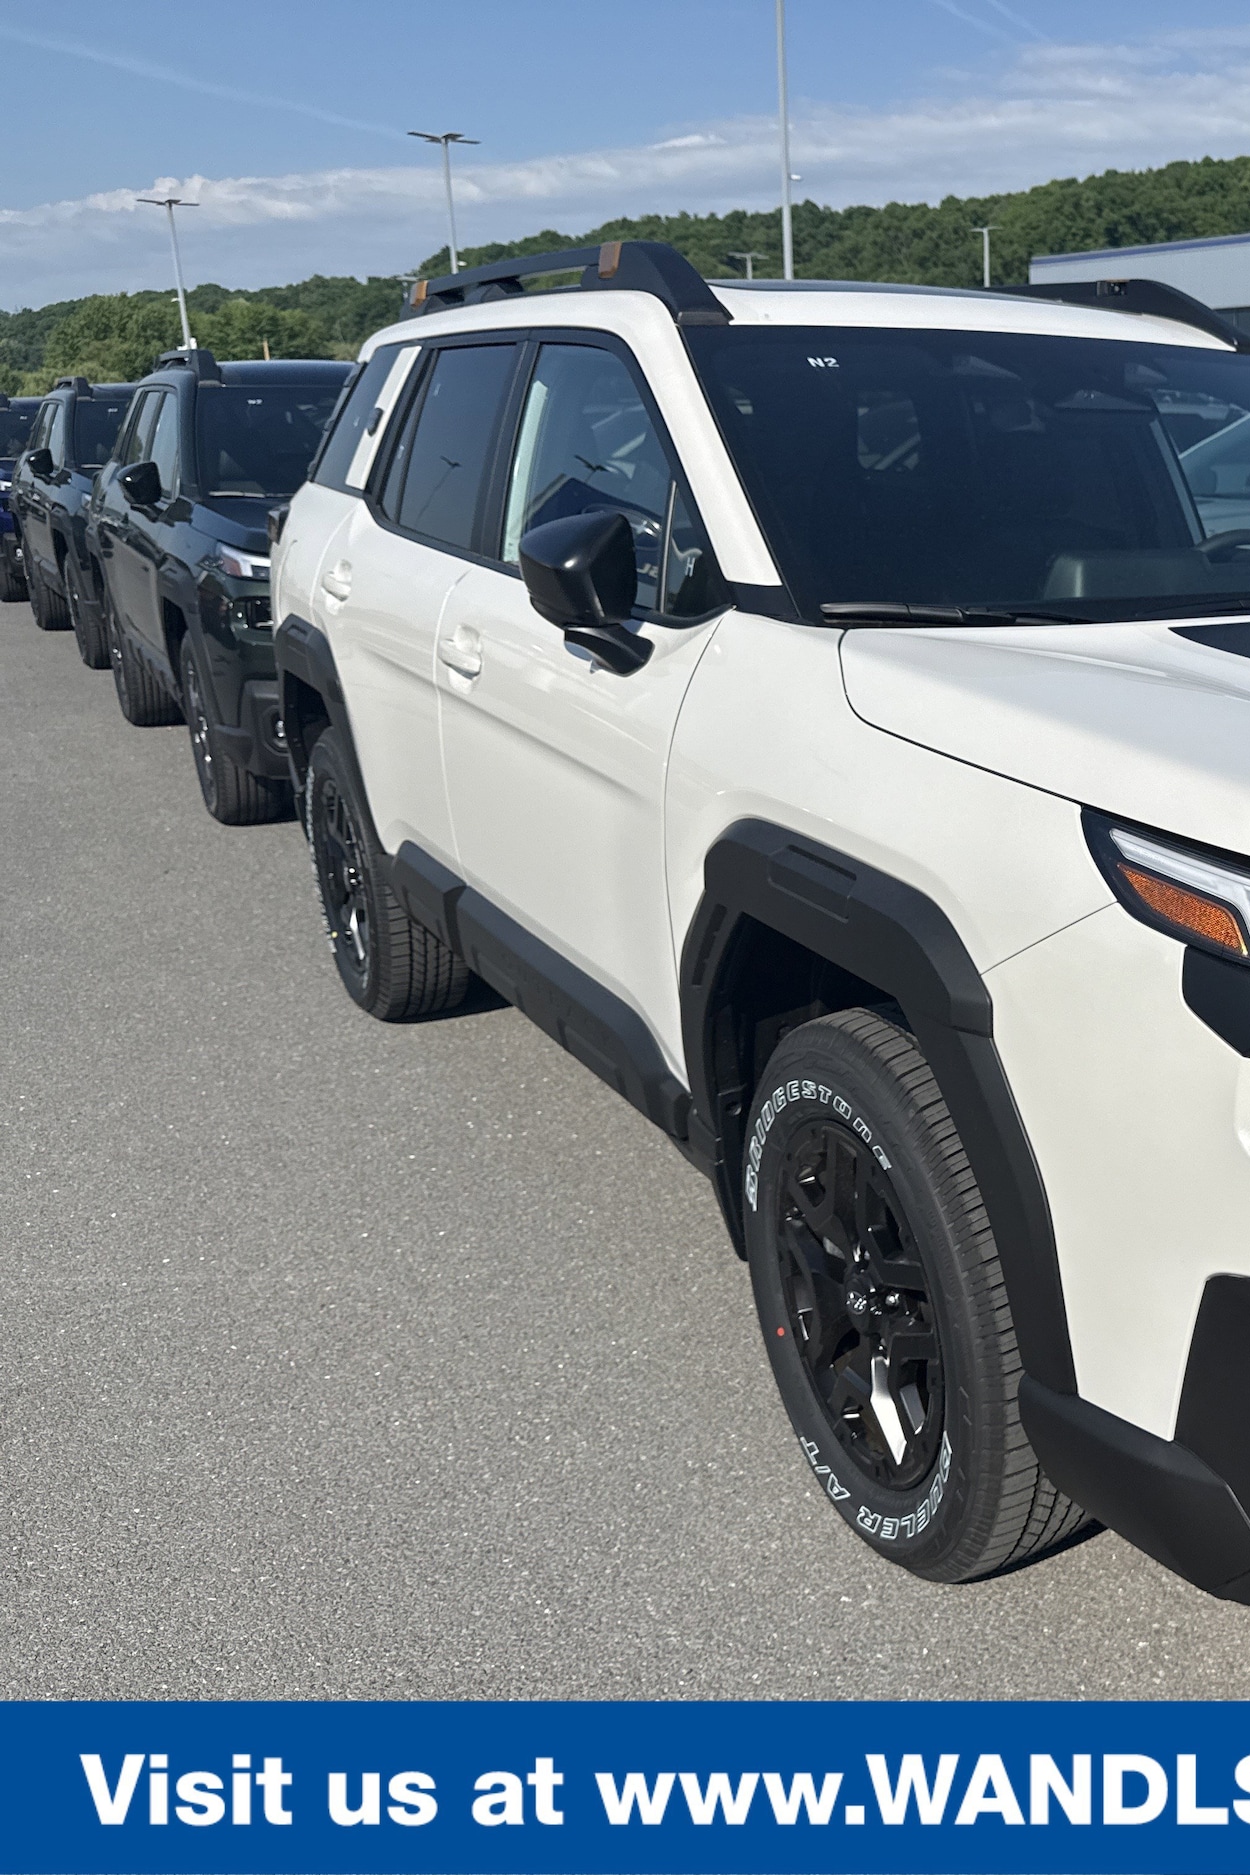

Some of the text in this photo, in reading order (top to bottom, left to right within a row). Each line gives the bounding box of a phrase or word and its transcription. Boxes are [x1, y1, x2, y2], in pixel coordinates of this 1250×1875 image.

[807, 357, 839, 368] N2
[745, 1079, 892, 1212] BRIDGESTONE
[856, 1431, 953, 1540] DUELER
